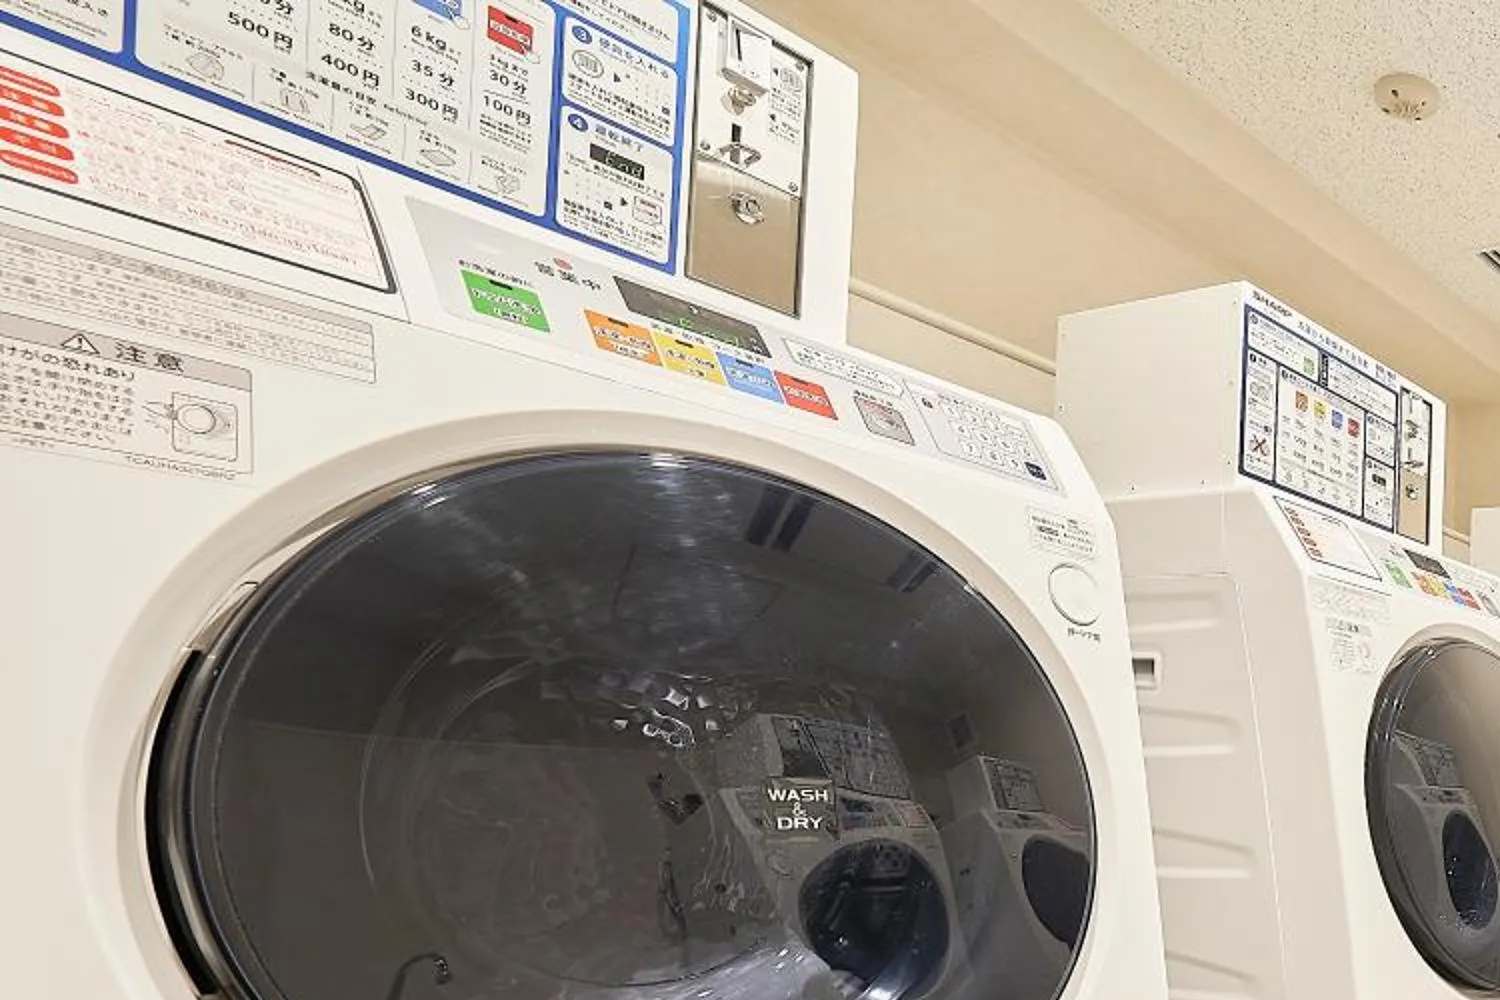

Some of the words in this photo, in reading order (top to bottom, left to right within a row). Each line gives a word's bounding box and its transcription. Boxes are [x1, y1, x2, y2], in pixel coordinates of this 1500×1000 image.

[228, 12, 293, 49] 500円
[328, 23, 374, 50] 80分
[321, 53, 380, 87] 400円
[411, 59, 455, 87] 35分
[490, 69, 527, 95] 30分
[405, 88, 459, 120] 300円
[484, 95, 531, 124] 100円
[115, 341, 185, 373] 注意
[768, 788, 828, 801] WASH
[792, 802, 807, 816] &
[777, 817, 823, 830] DRY
